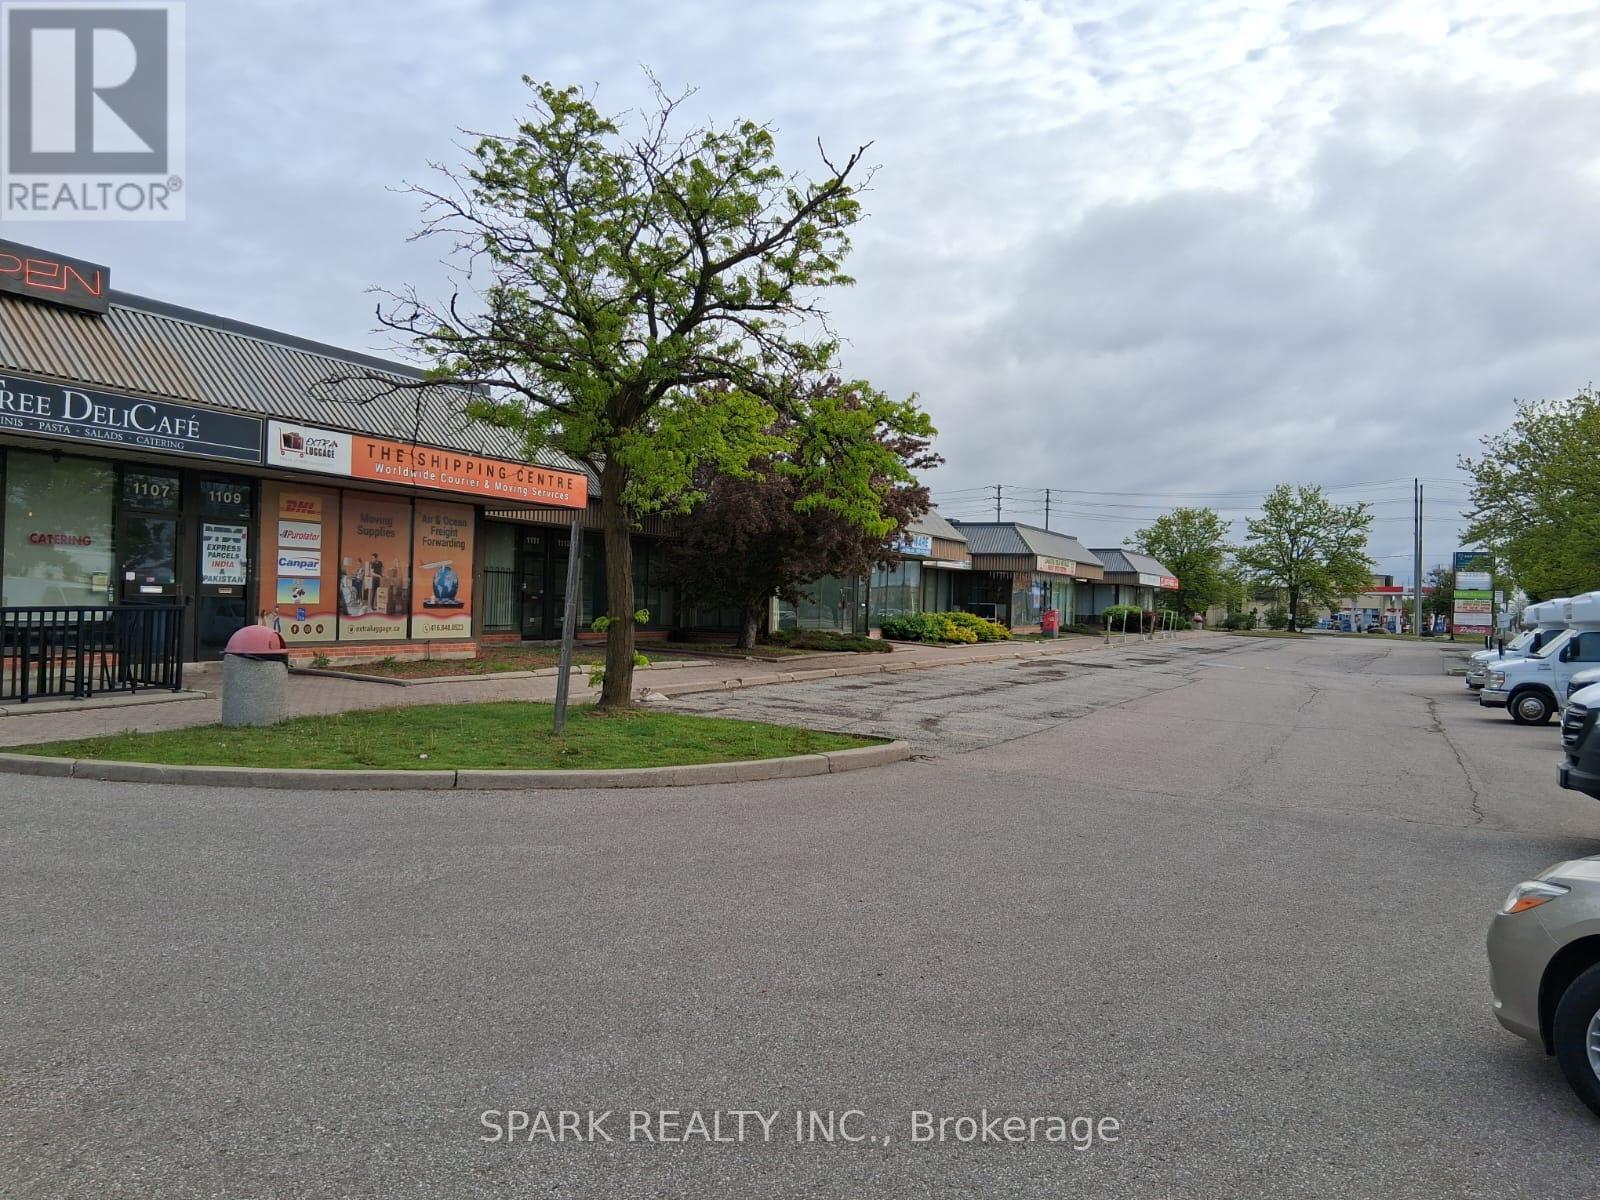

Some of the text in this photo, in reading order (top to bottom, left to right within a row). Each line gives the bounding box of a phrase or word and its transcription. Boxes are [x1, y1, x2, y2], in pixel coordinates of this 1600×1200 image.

[39, 421, 71, 434] PASTA
[85, 428, 124, 441] SALADS
[136, 436, 185, 450] CATERING
[305, 447, 336, 459] LUGGAGE
[367, 444, 573, 490] THE SHIPPING CENTRE
[375, 463, 569, 500] Worldwide Courier & Moving Services
[134, 482, 170, 497] 1107
[209, 490, 241, 504] 1109
[360, 511, 393, 528] Moving
[422, 514, 432, 524] Air
[443, 515, 467, 527] Ocean
[286, 530, 320, 541] Purolator
[357, 525, 396, 539] Supplies
[430, 526, 458, 539] Freight
[29, 532, 92, 546] CATERING
[422, 536, 466, 550] Forwarding
[206, 543, 242, 552] EXPRESS
[207, 551, 240, 559] PARCELS
[211, 560, 234, 568] INDIA
[278, 557, 320, 568] Canpar
[202, 575, 245, 583] PAKISTAN
